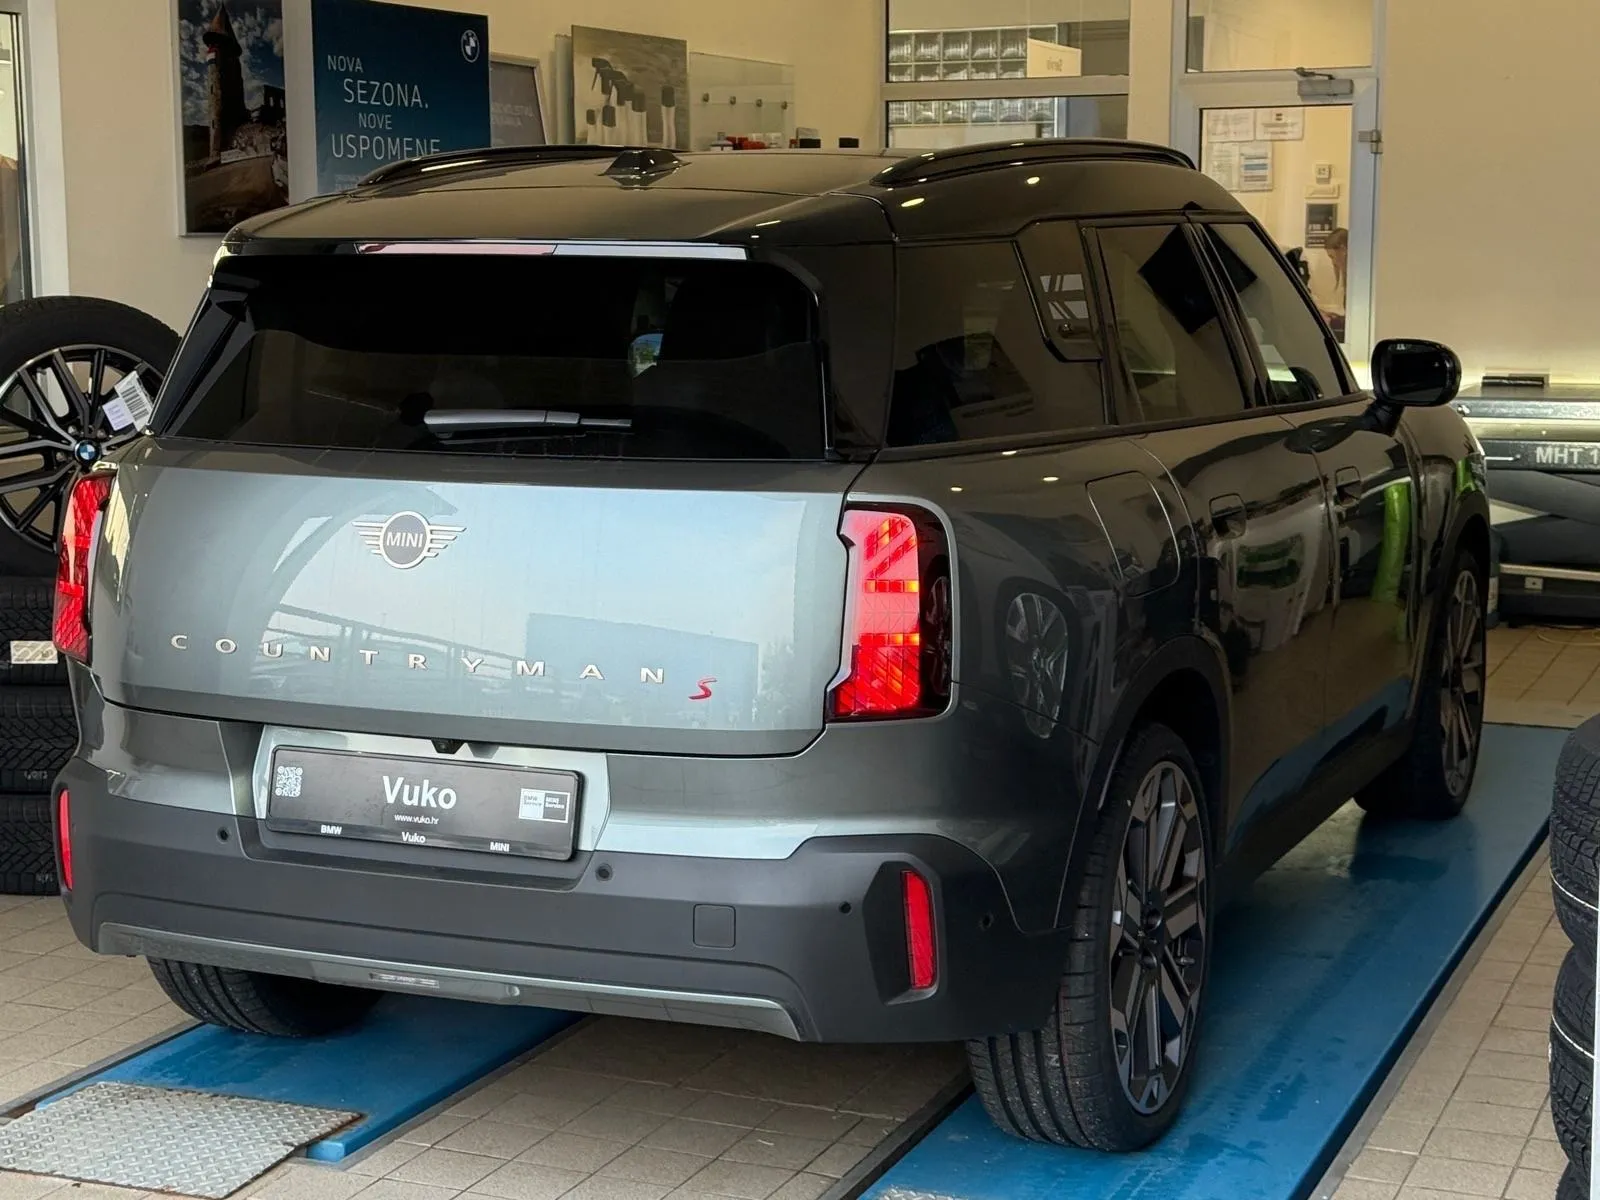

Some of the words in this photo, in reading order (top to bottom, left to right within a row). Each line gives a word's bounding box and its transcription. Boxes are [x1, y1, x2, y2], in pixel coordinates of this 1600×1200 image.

[327, 54, 364, 73] NOVA
[343, 78, 429, 109] SEZONA.
[358, 112, 392, 130] NOVE
[1536, 446, 1583, 464] MHT
[386, 531, 423, 548] MINI
[171, 633, 664, 684] COUNTRYMAN
[688, 676, 717, 700] S
[382, 775, 457, 810] Vuko
[394, 813, 440, 826] www.vuko.hr
[320, 824, 342, 836] BMW
[401, 831, 426, 844] Vuko
[490, 841, 510, 853] MINI
